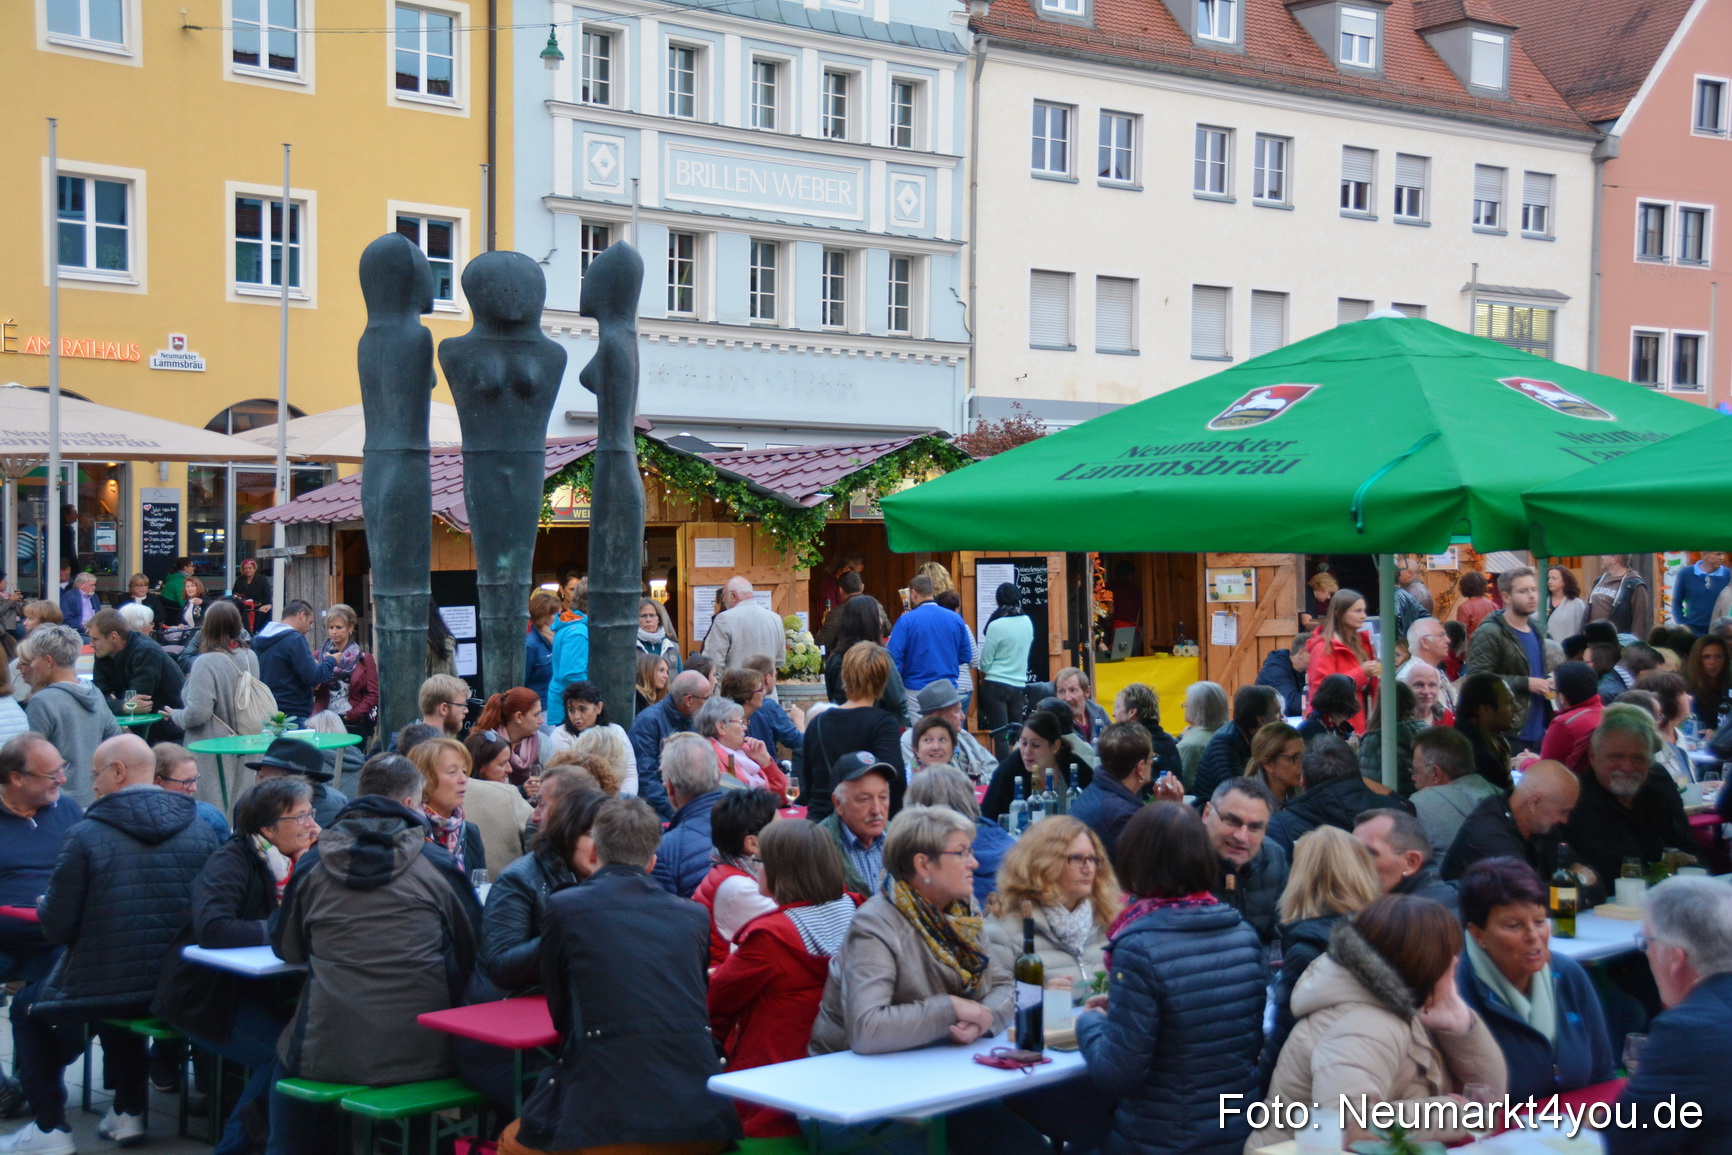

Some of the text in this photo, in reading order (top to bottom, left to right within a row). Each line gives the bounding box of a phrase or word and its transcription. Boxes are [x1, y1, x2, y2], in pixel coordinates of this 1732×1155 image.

[676, 159, 853, 206] BRILLEN WEBER
[60, 338, 141, 362] RATHAUS
[160, 351, 197, 361] Neumarkter
[153, 358, 203, 370] Lammsbräu
[1117, 438, 1299, 459] Neumarkter
[1054, 455, 1303, 481] Lammsbräu
